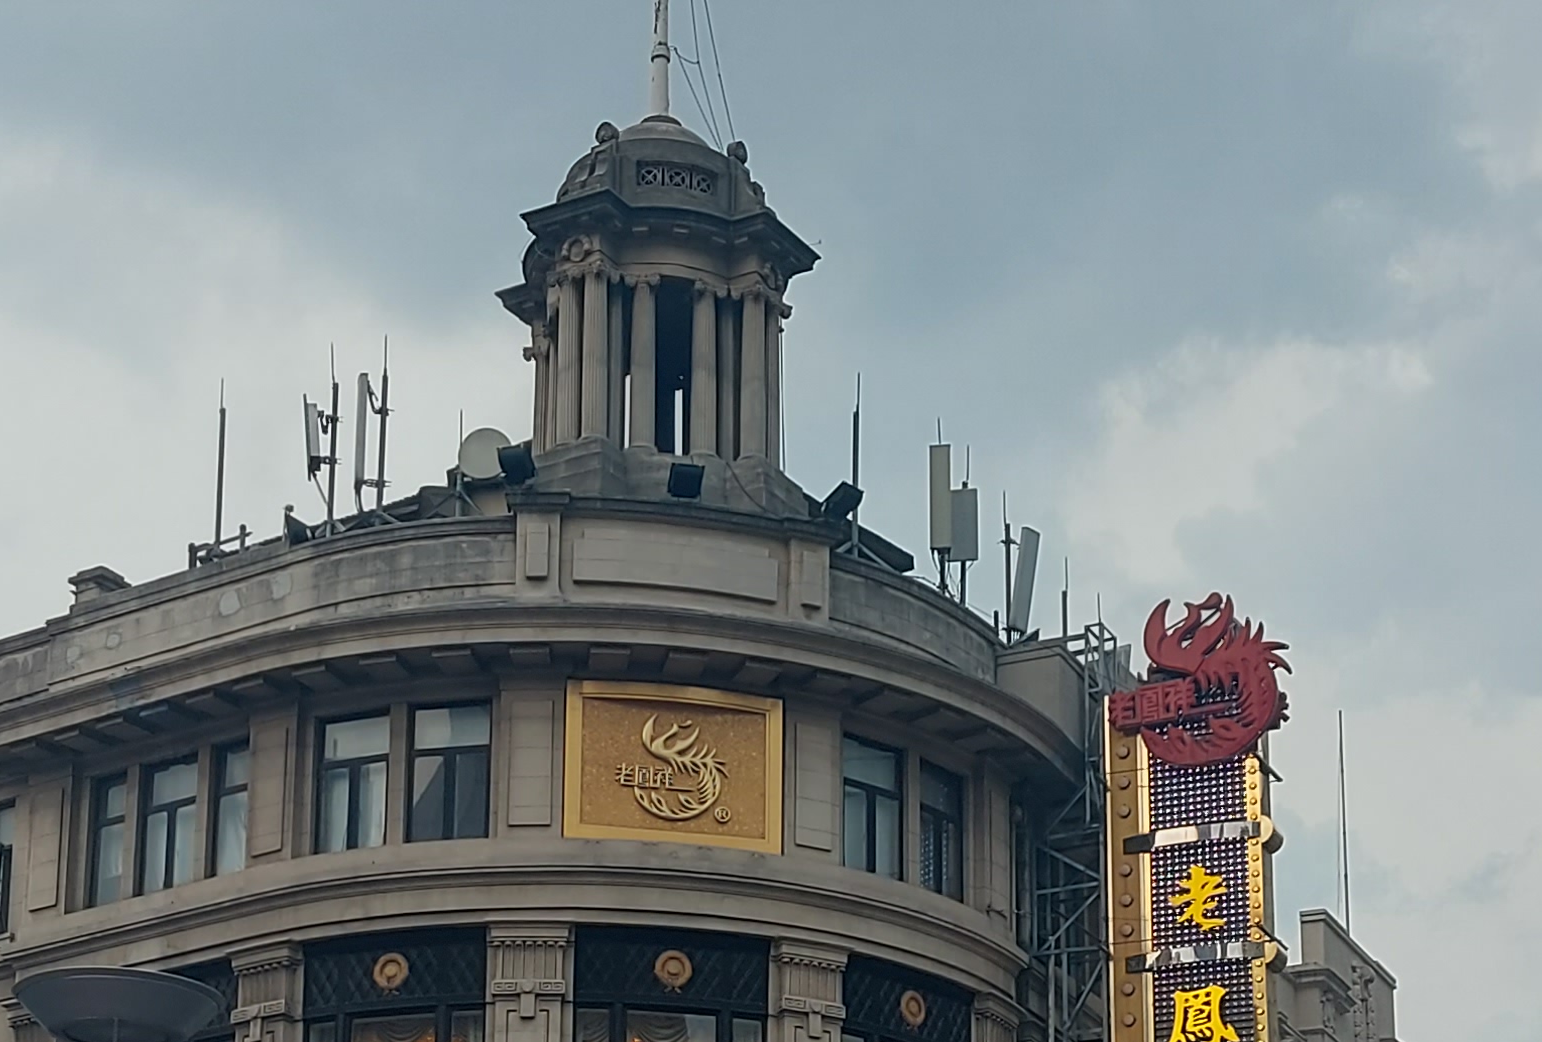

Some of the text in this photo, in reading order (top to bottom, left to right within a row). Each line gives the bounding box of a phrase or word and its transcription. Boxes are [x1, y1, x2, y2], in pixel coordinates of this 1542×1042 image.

[1109, 677, 1197, 728] 老鳳祥
[614, 762, 674, 789] 老鳳祥
